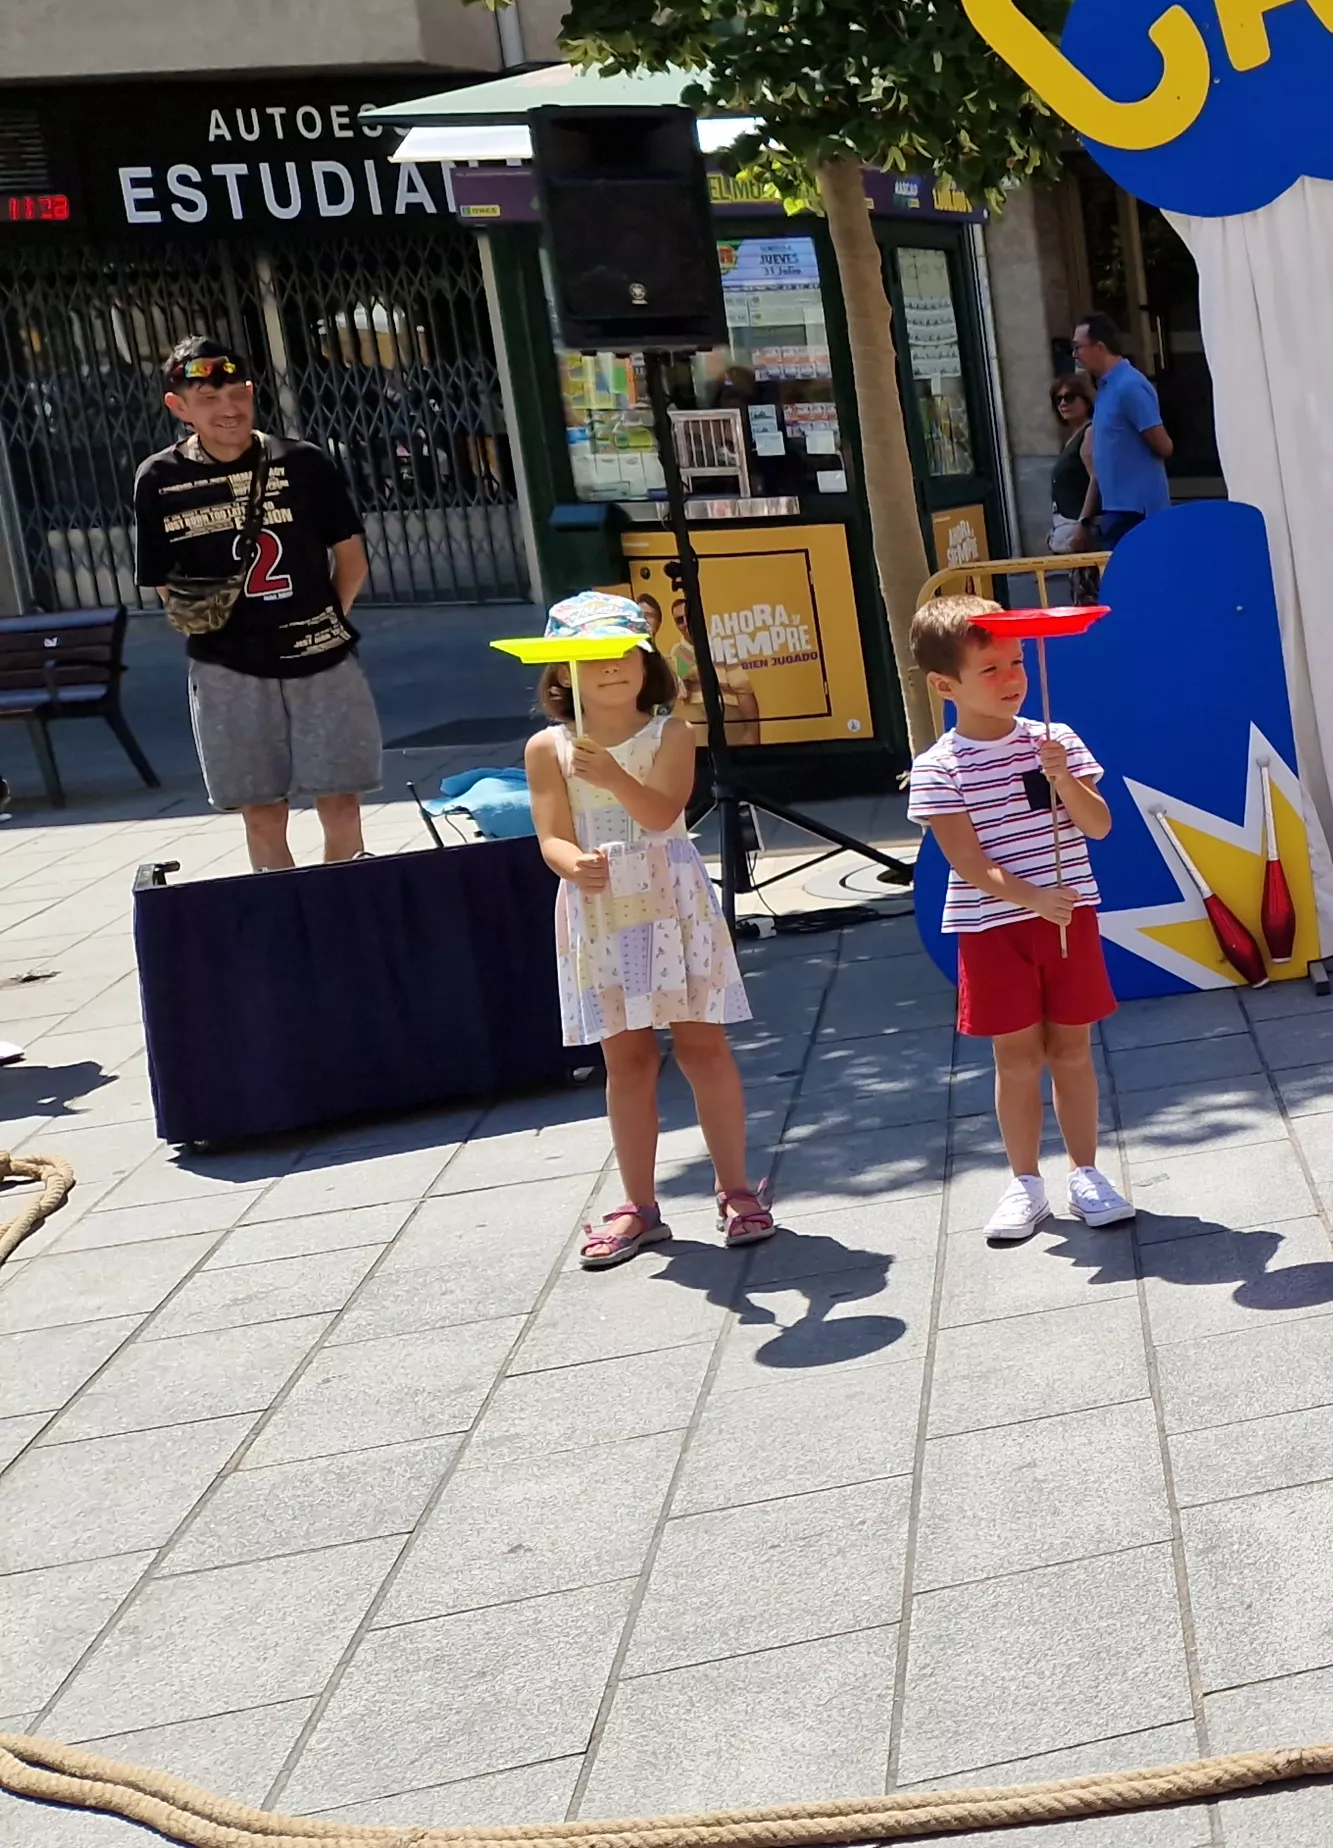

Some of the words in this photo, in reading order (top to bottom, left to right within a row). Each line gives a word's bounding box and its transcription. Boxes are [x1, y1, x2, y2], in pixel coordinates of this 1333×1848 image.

[208, 104, 412, 142] AUTOES
[232, 528, 293, 598] 2
[711, 603, 790, 637] AHORA
[741, 658, 769, 670] BIEN
[771, 651, 819, 667] JUGADO
